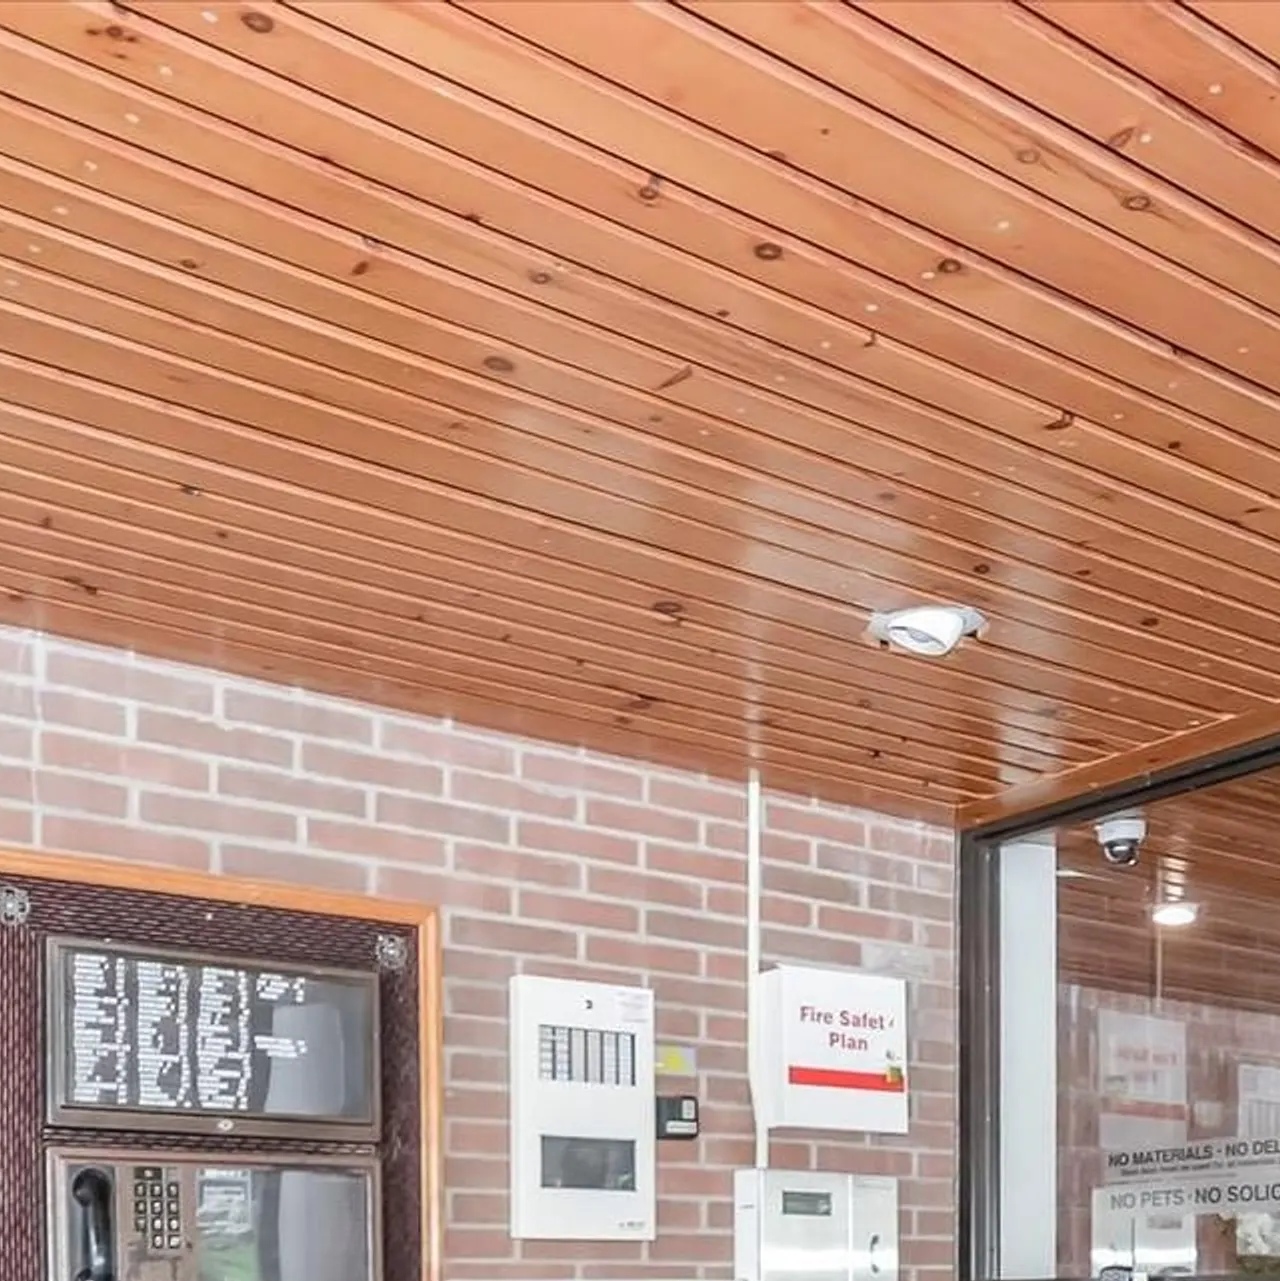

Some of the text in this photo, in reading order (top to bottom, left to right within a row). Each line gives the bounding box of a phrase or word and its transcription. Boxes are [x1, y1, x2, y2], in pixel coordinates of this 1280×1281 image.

[800, 1005, 834, 1025] Fire
[829, 1031, 868, 1051] Plan
[1108, 1152, 1129, 1168] NO
[1132, 1145, 1213, 1166] MATERIALS
[1225, 1141, 1249, 1157] NO
[1111, 1194, 1136, 1210] NO
[1140, 1189, 1185, 1208] PETS
[1195, 1186, 1221, 1204] NO
